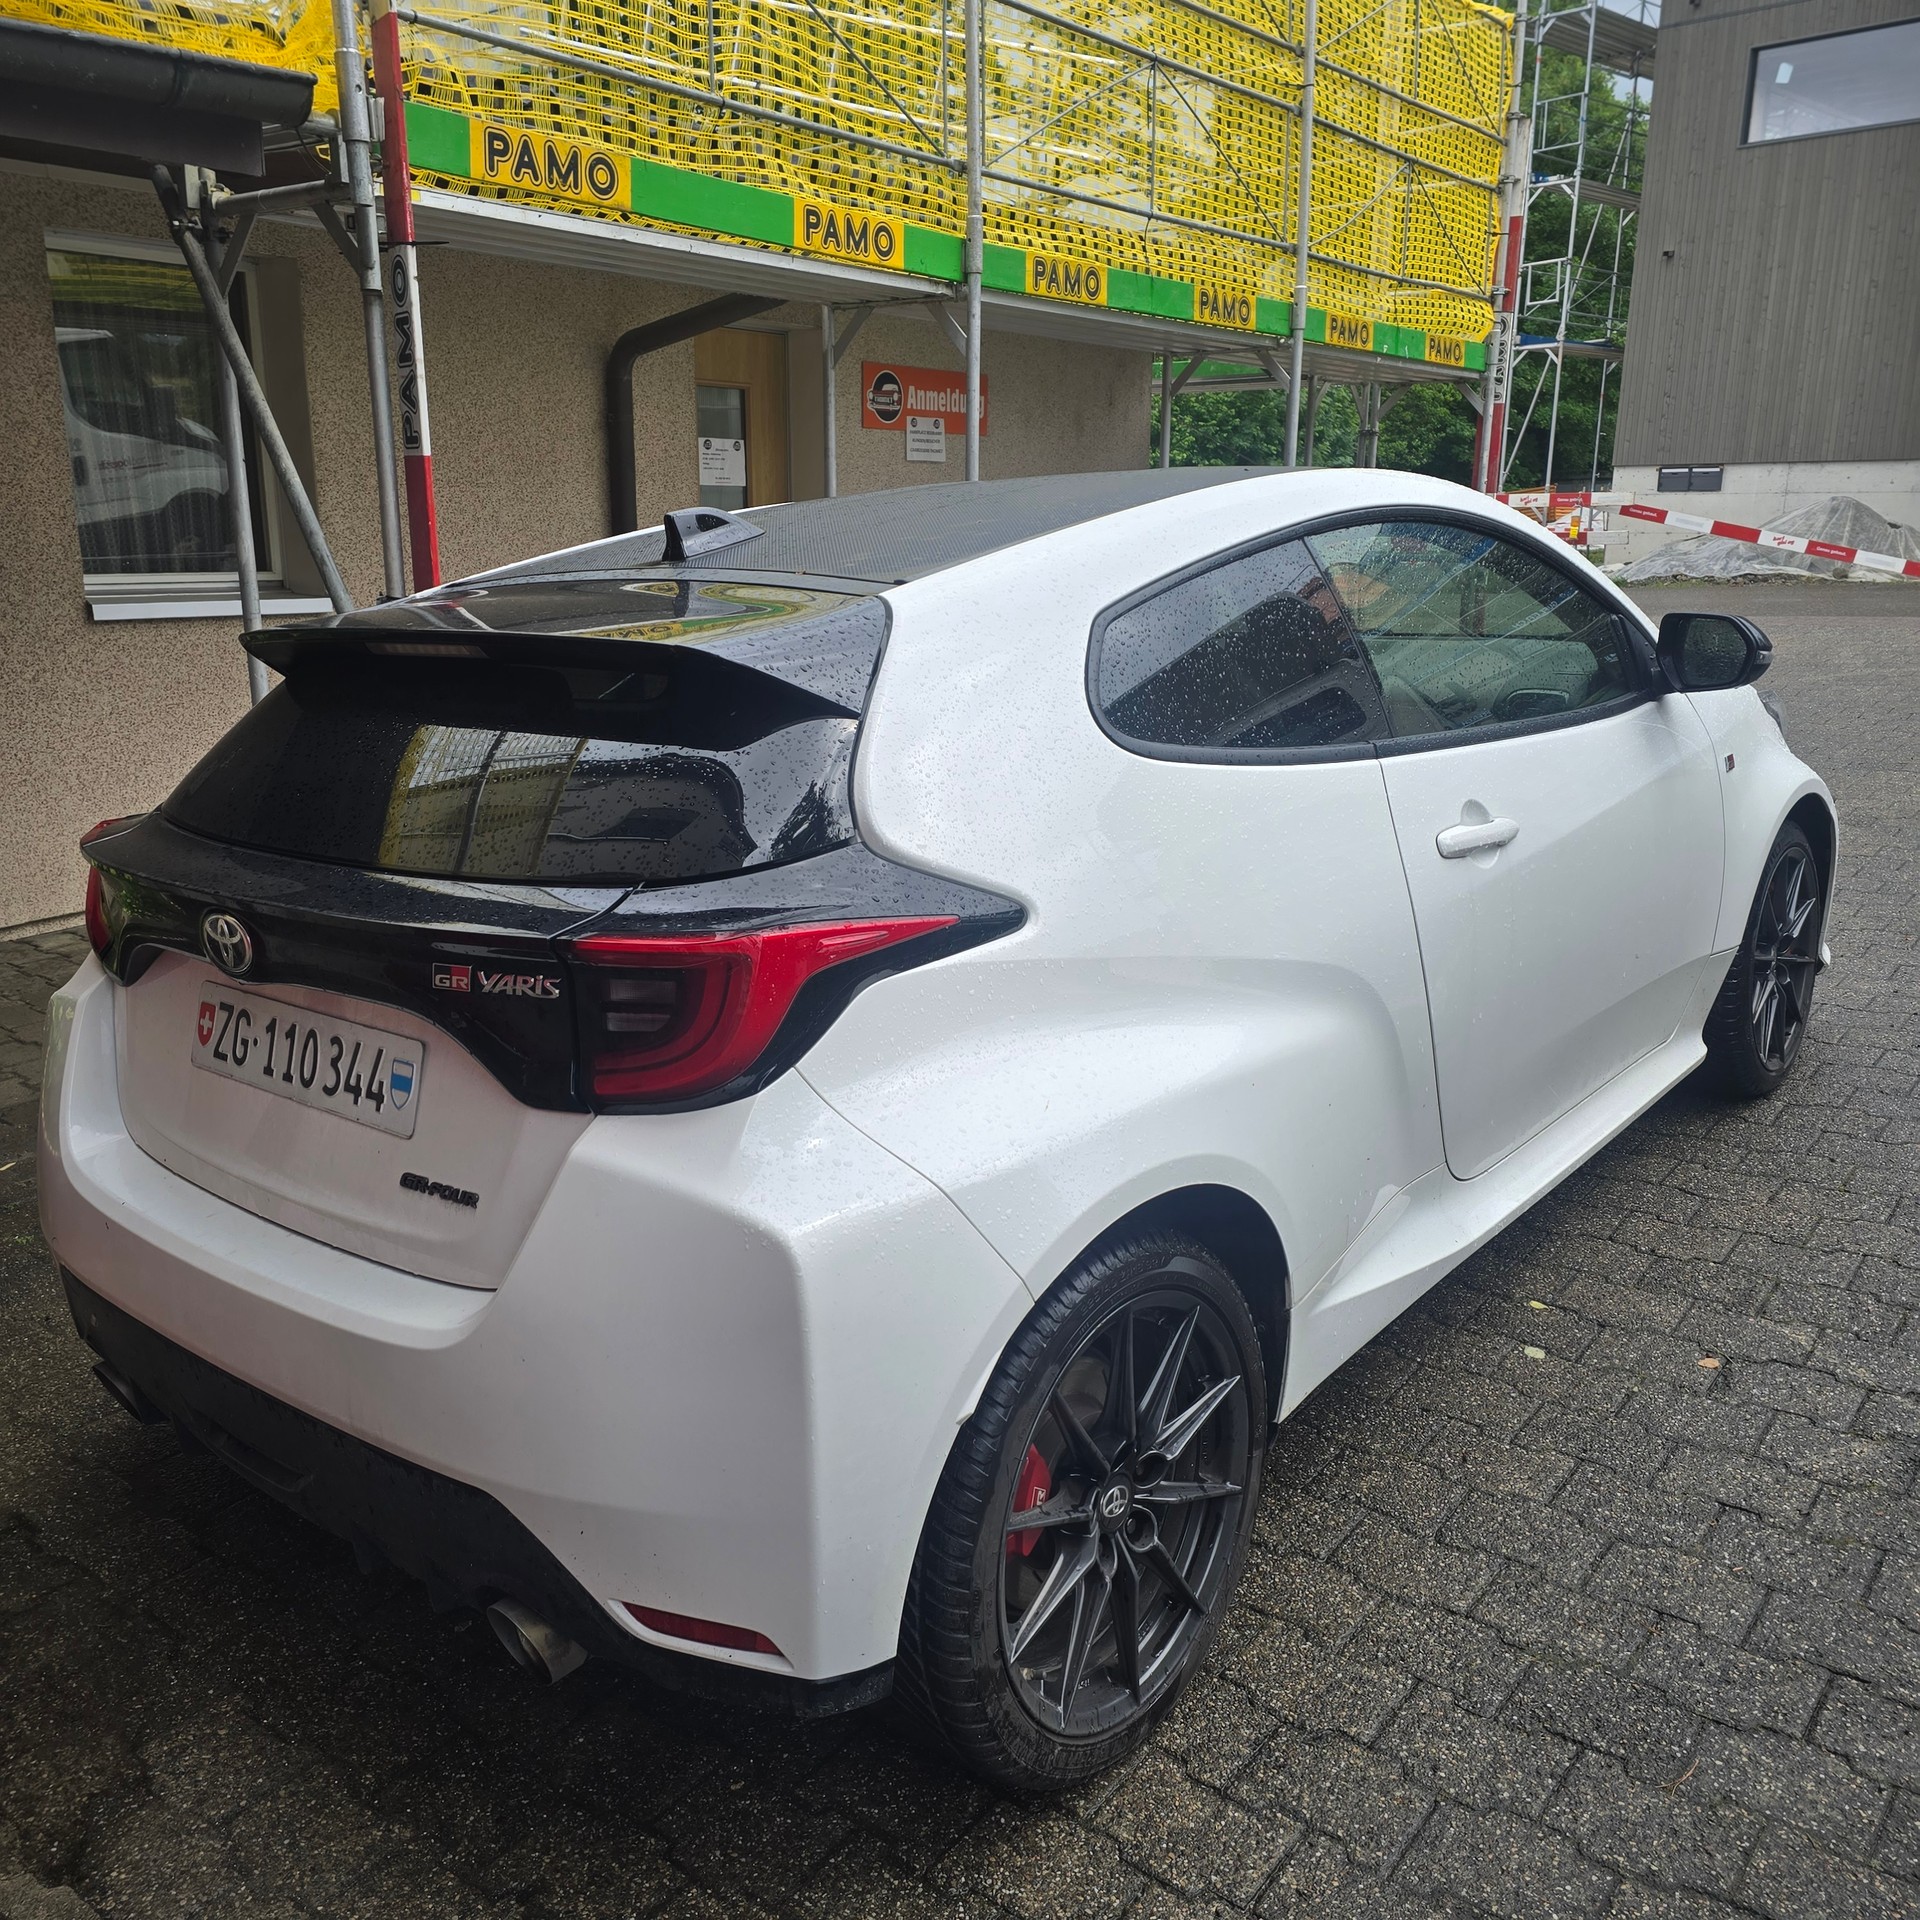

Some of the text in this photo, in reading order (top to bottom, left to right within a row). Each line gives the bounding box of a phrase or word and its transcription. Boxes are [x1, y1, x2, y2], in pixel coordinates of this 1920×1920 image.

[483, 126, 621, 203] PAMO
[803, 203, 896, 262] PAMO
[1032, 254, 1102, 301] PAMO
[1199, 287, 1251, 326] PAMO
[1329, 314, 1371, 349] PAMO
[1428, 334, 1463, 366] PAMO
[391, 254, 421, 450] PAMO
[907, 385, 985, 419] Anmeldug
[434, 973, 469, 990] GR
[399, 1171, 480, 1209] GR-FOUR
